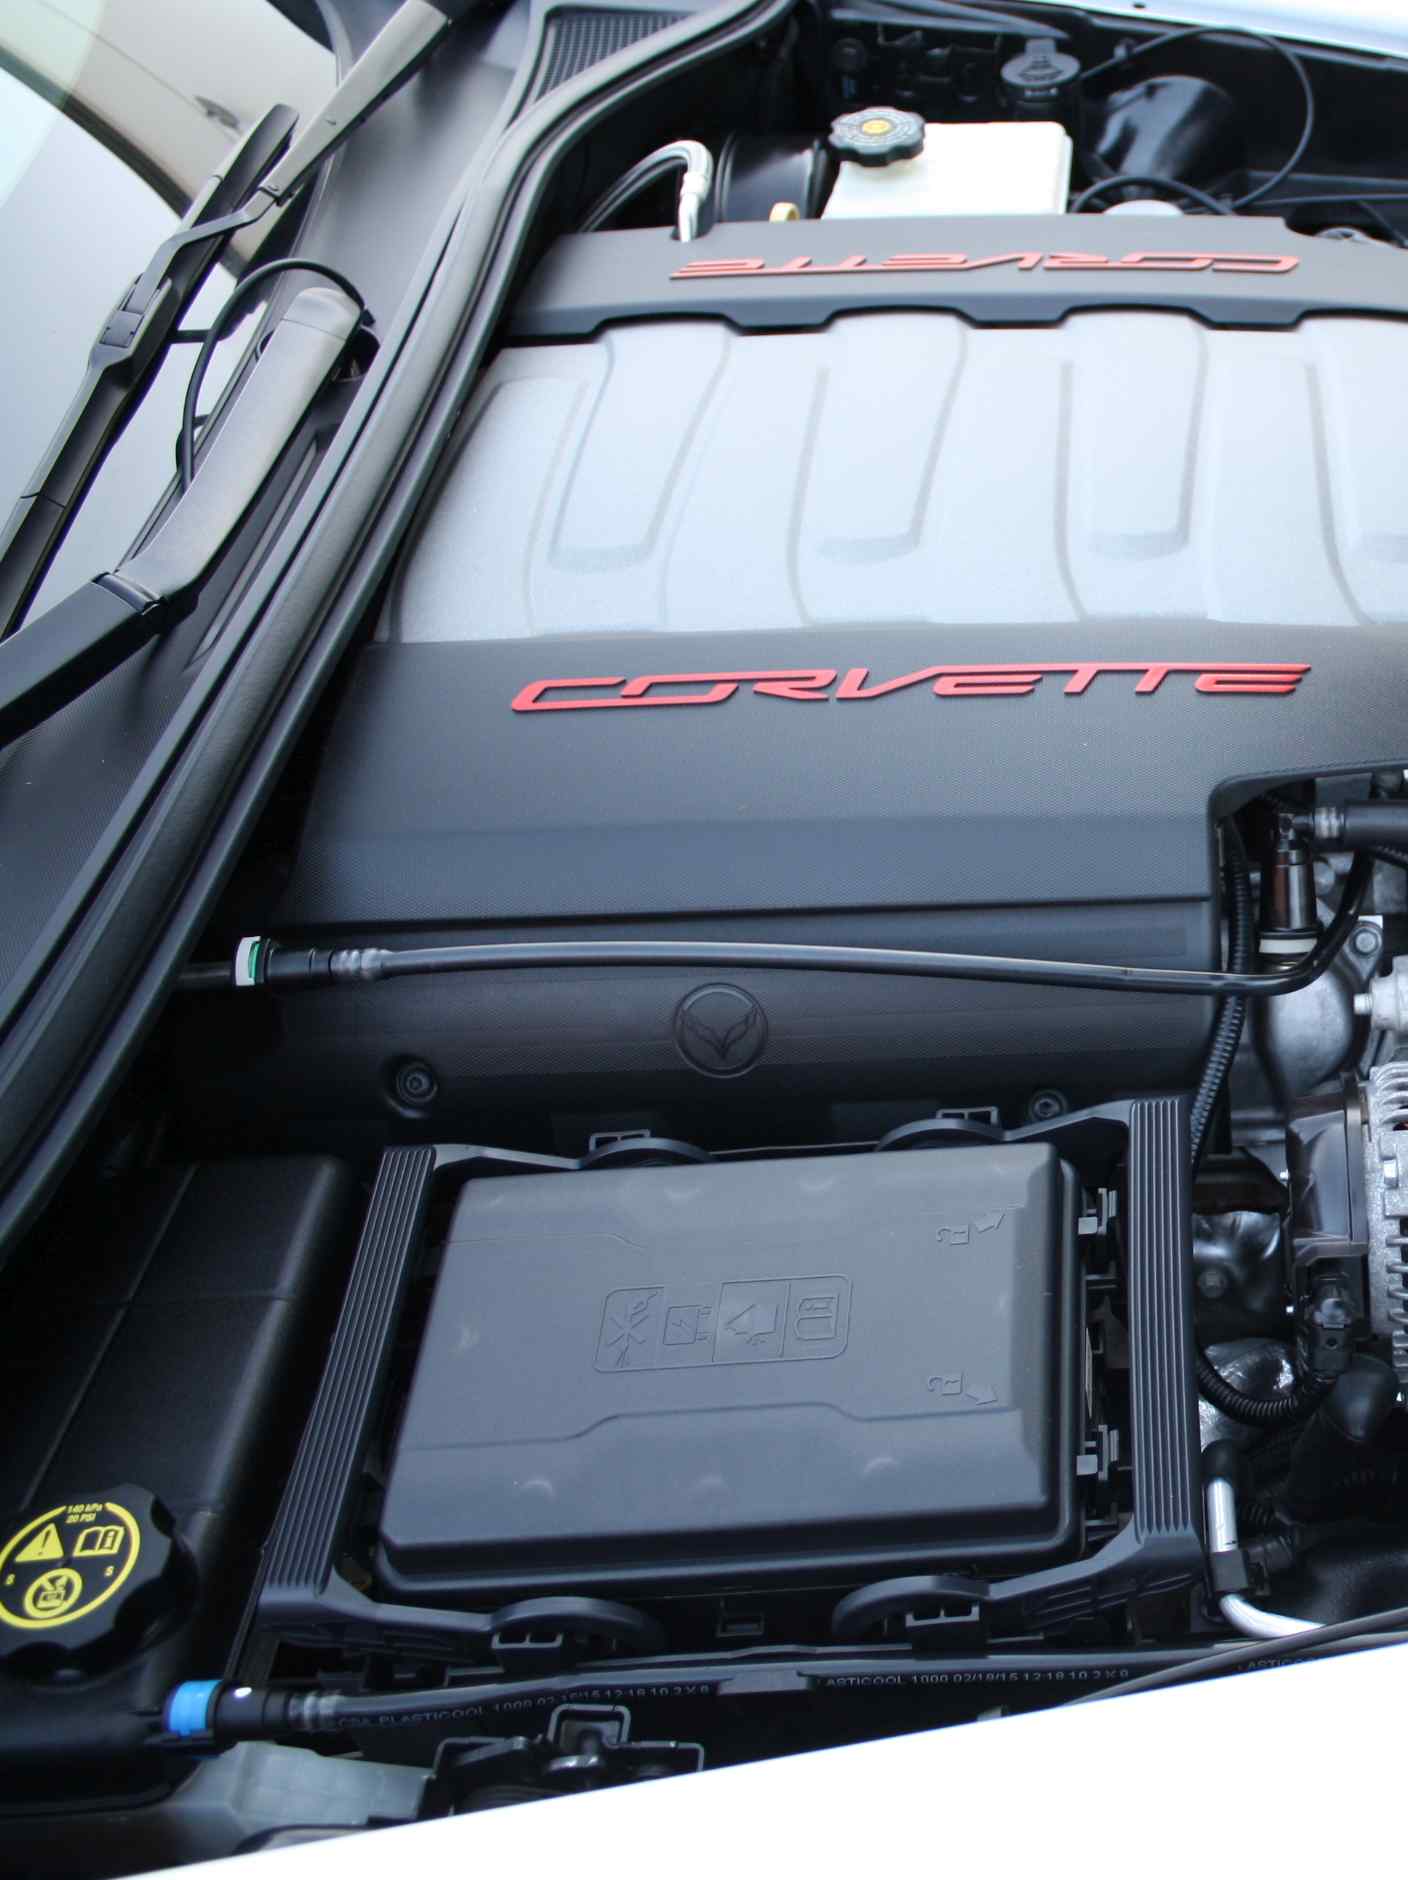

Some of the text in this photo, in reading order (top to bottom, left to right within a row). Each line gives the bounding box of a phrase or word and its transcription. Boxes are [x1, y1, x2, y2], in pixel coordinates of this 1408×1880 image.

[670, 251, 1299, 281] CORVETTE
[510, 662, 1311, 712] CORVETTE
[80, 1511, 97, 1523] PSI
